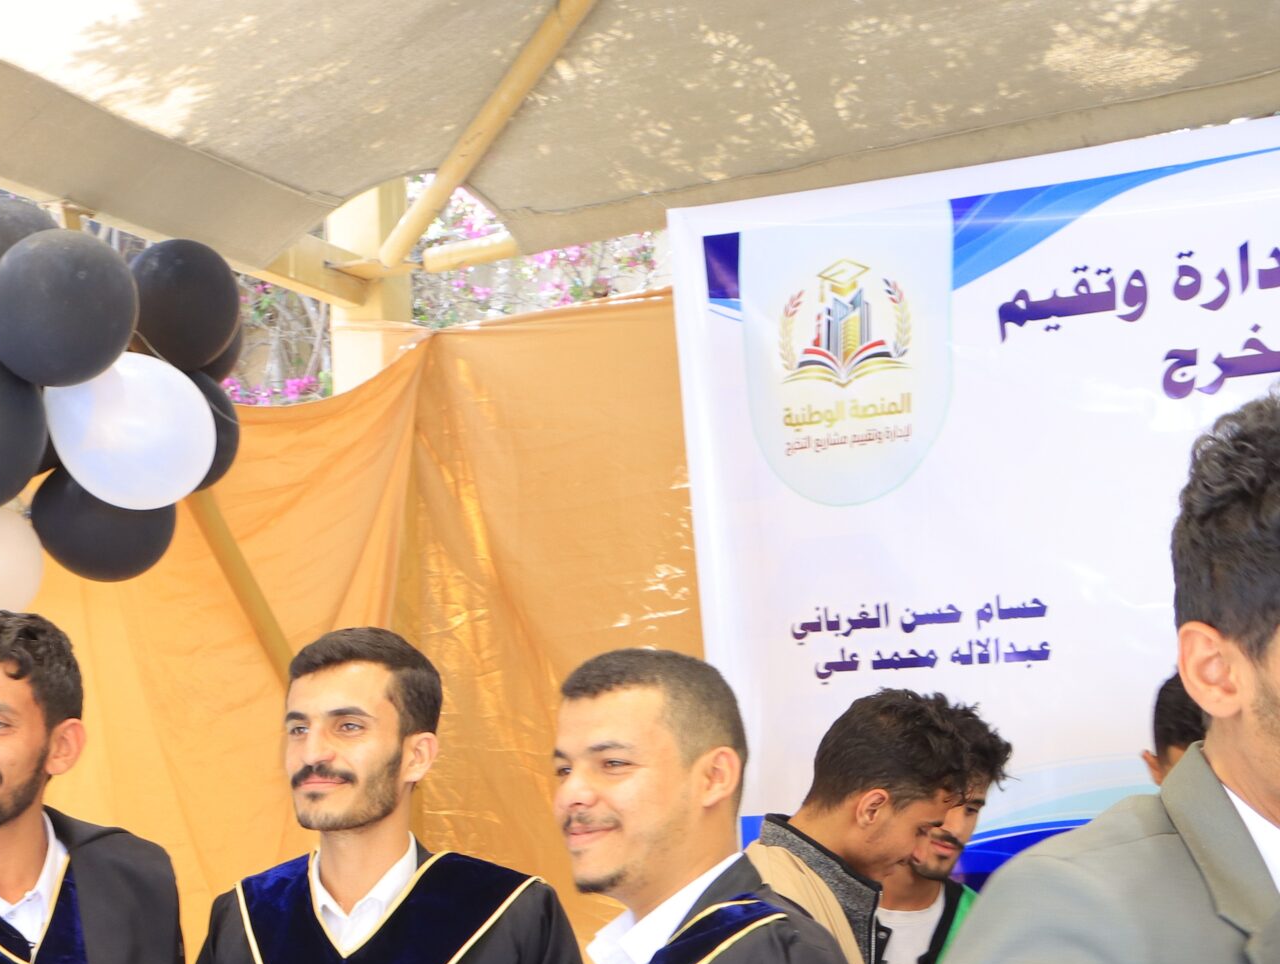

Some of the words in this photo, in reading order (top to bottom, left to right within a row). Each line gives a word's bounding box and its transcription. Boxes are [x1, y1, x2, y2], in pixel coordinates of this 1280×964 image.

[1173, 240, 1280, 311] دارة
[998, 265, 1148, 343] وتقيم
[1162, 323, 1280, 400] خرج
[783, 400, 845, 432] الوطنية
[849, 392, 912, 419] المنصة
[792, 601, 889, 646] الغرباني
[900, 603, 962, 633] حسن
[976, 594, 1048, 630] حسام
[815, 648, 859, 685] علي
[871, 648, 938, 670] محمد
